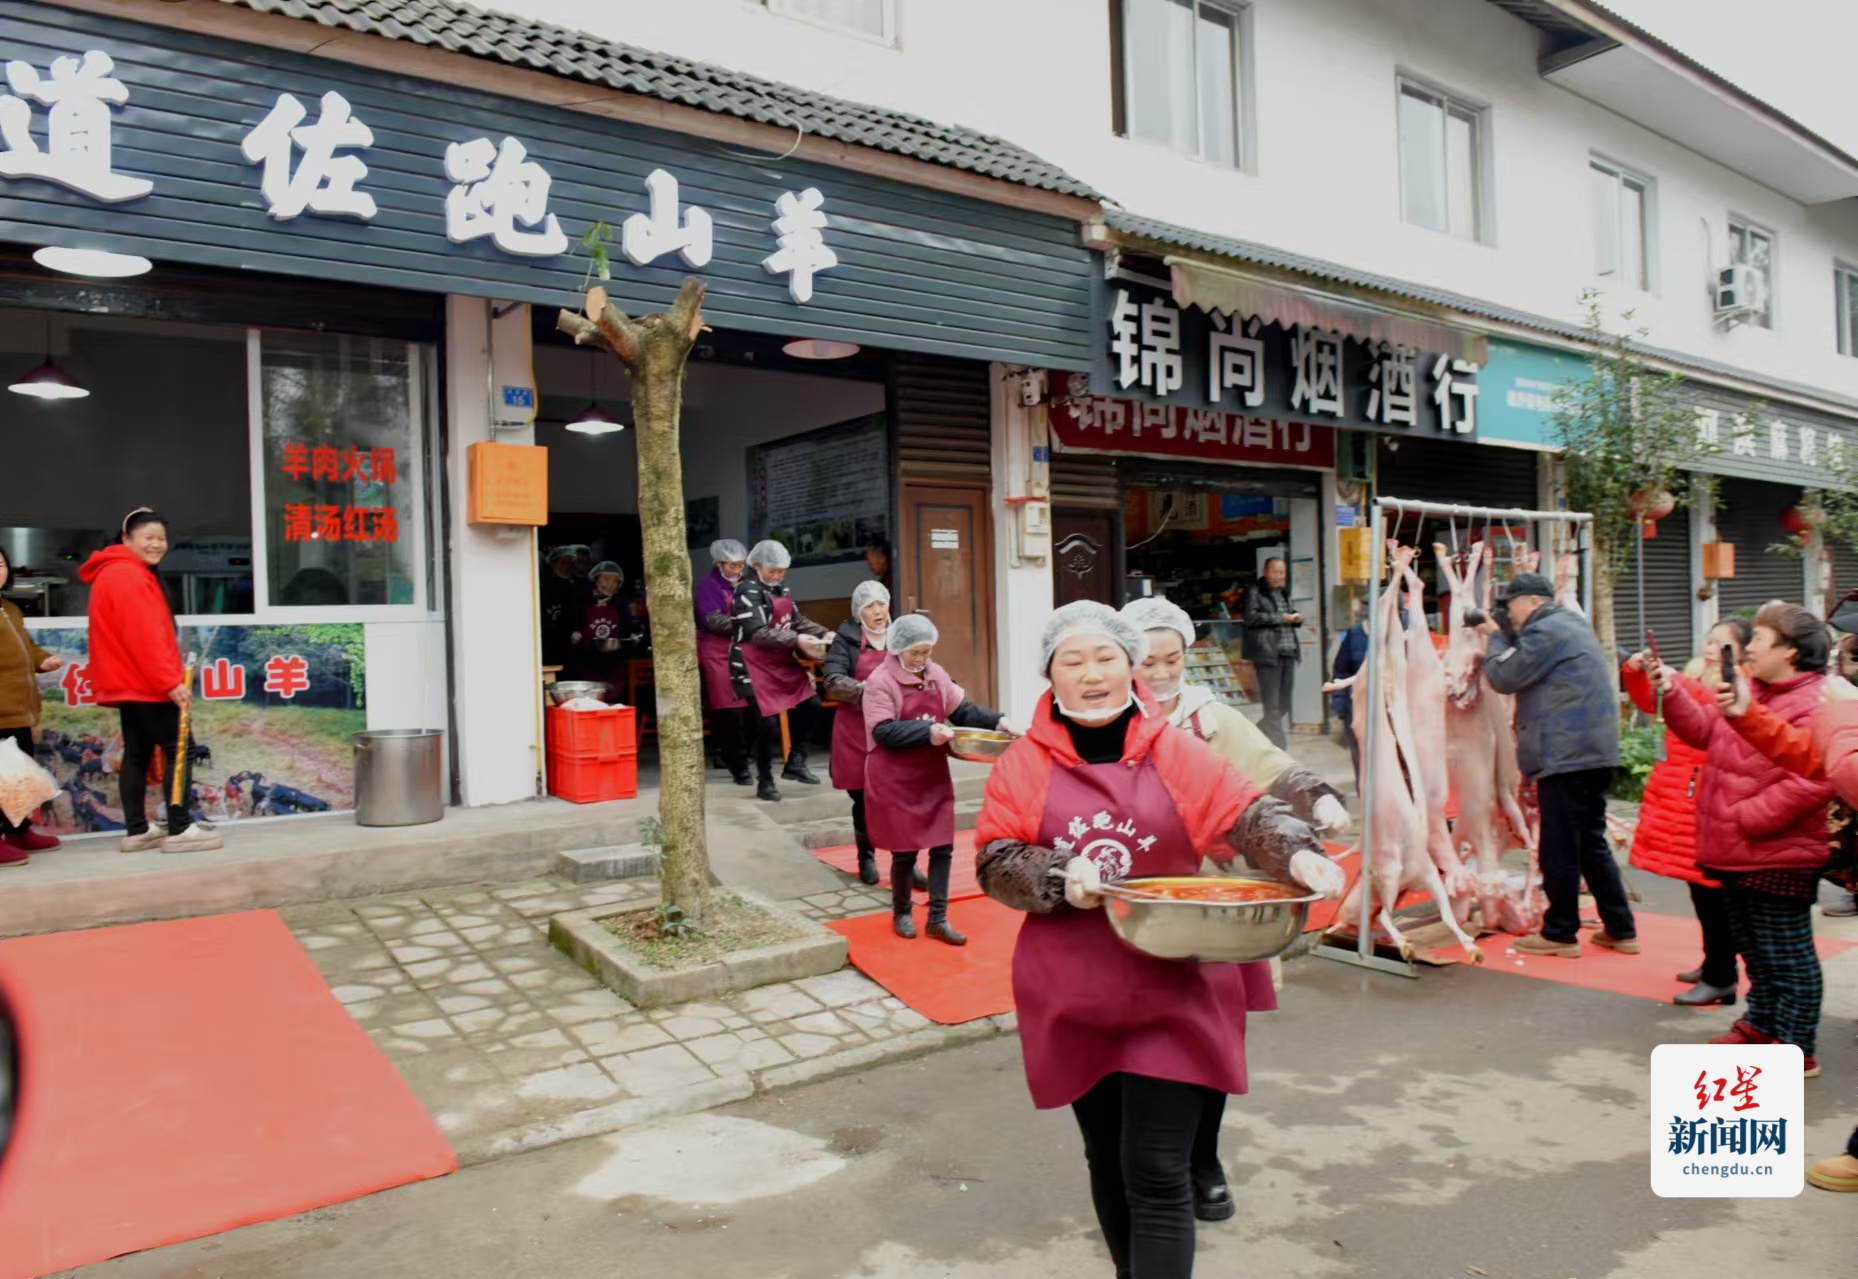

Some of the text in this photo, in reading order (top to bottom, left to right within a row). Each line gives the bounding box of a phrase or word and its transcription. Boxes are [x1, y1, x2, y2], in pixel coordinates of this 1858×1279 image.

[0, 50, 838, 304] 道佐跑山羊
[1103, 288, 1481, 434] 锦尚烟酒行
[281, 440, 397, 484] 羊肉火锅
[284, 503, 399, 543] 清汤红汤
